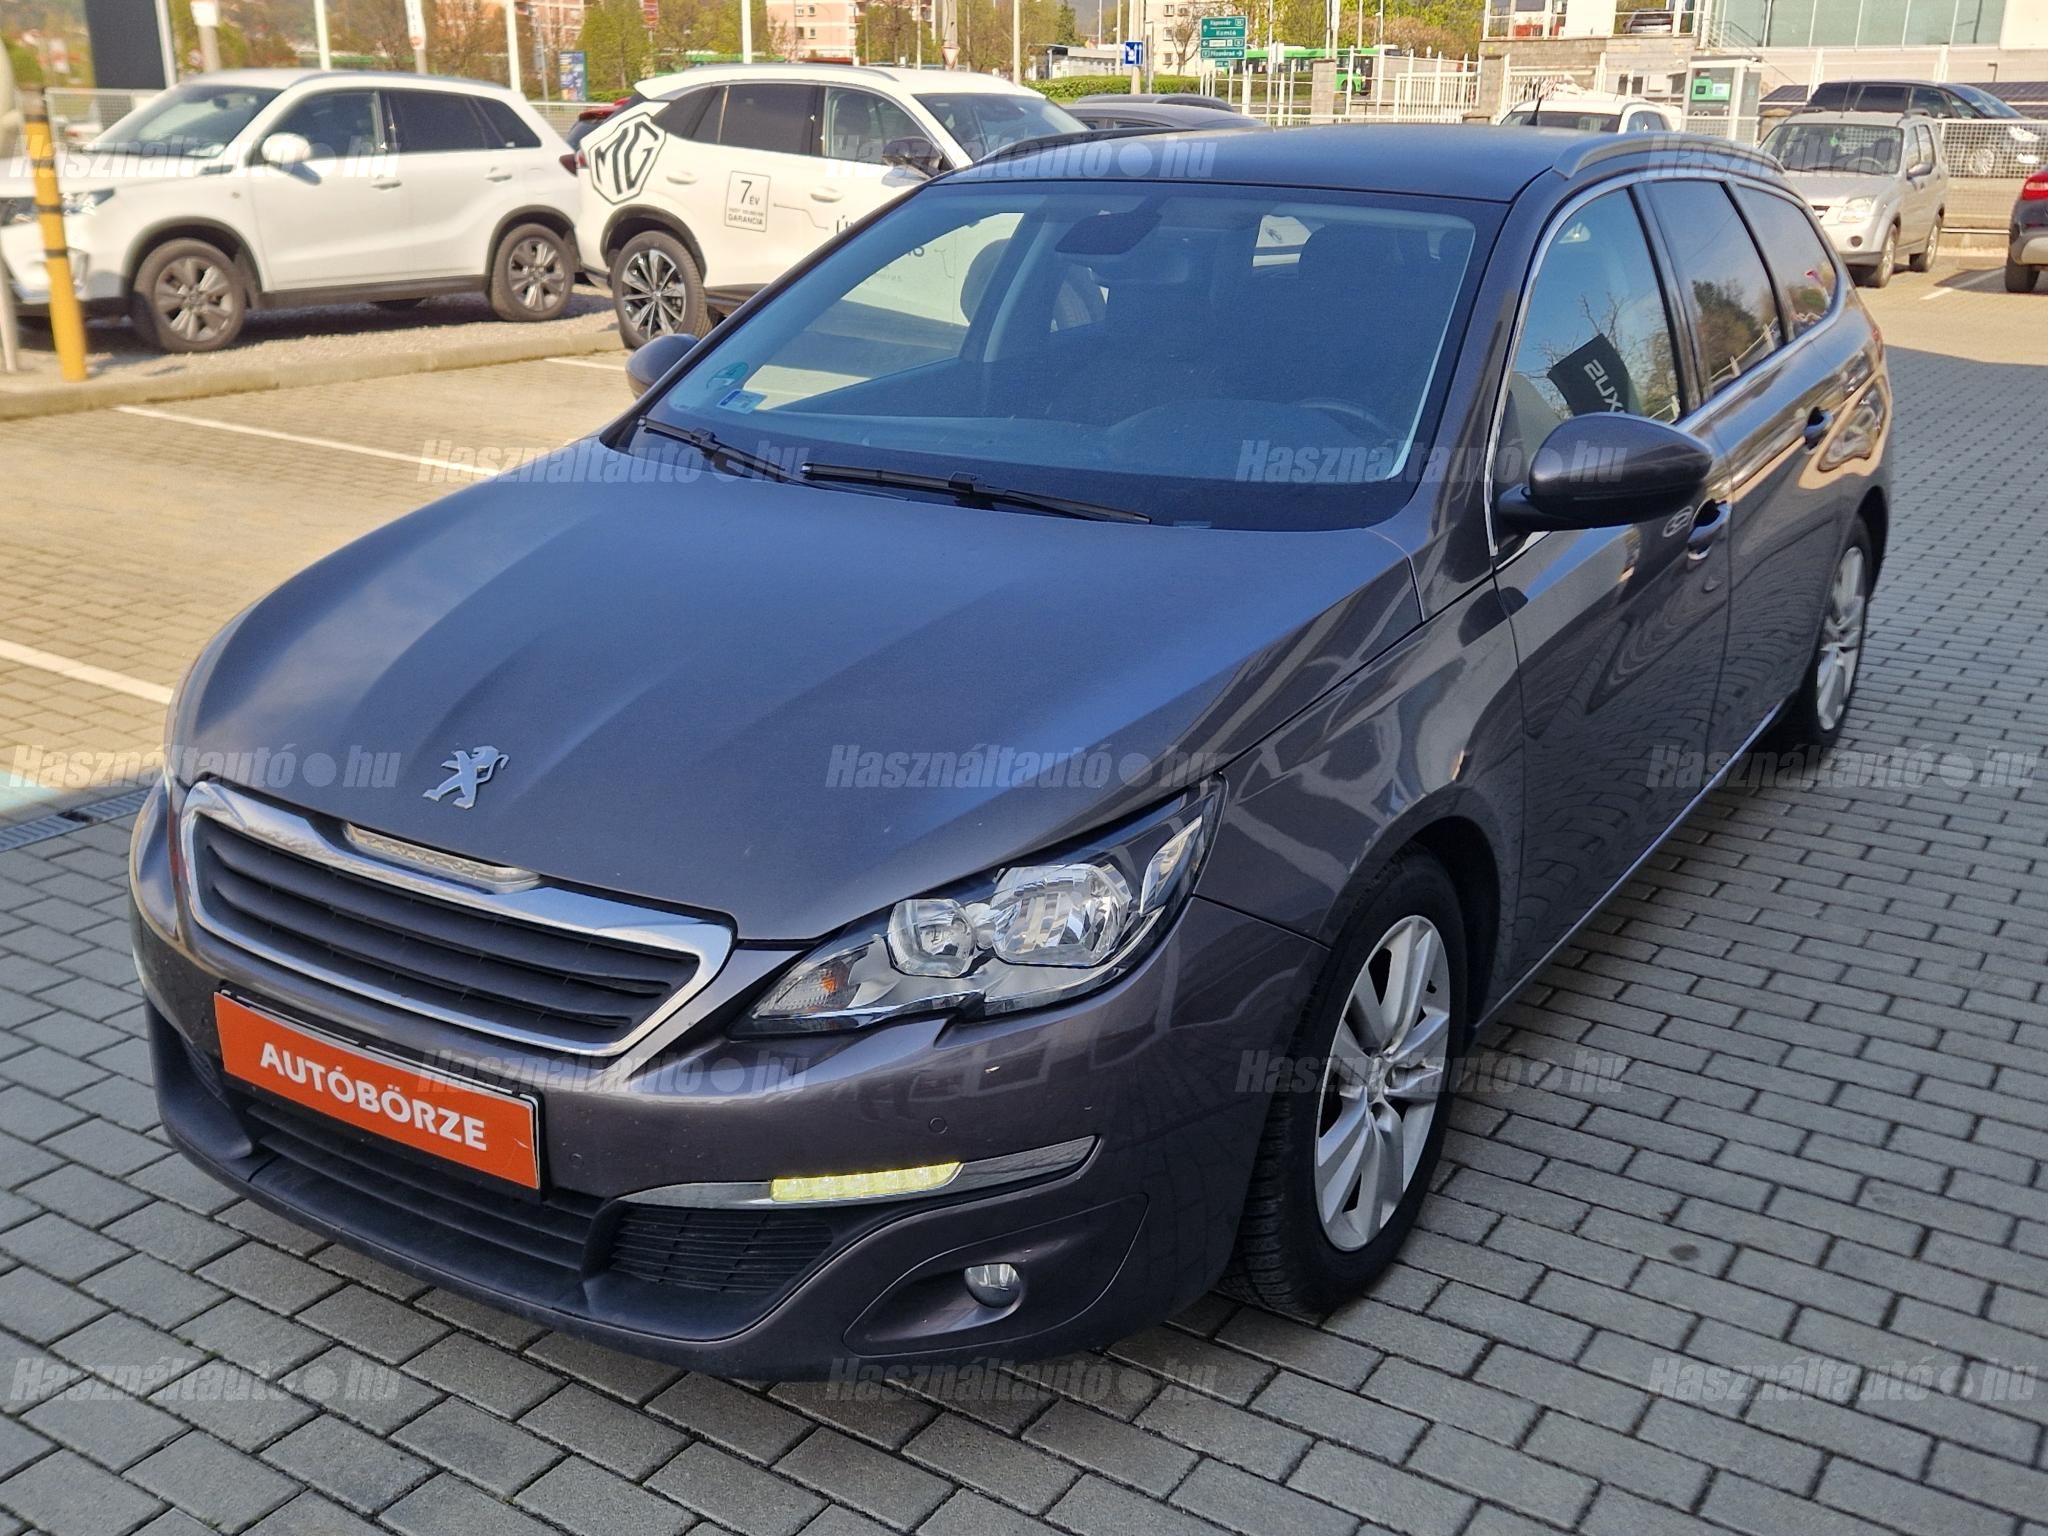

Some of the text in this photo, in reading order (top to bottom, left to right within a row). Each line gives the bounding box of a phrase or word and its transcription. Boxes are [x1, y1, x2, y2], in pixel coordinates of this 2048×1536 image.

[594, 121, 659, 195] MG
[740, 179, 752, 204] 7
[260, 1042, 487, 1151] AUTÓBÖRZE
